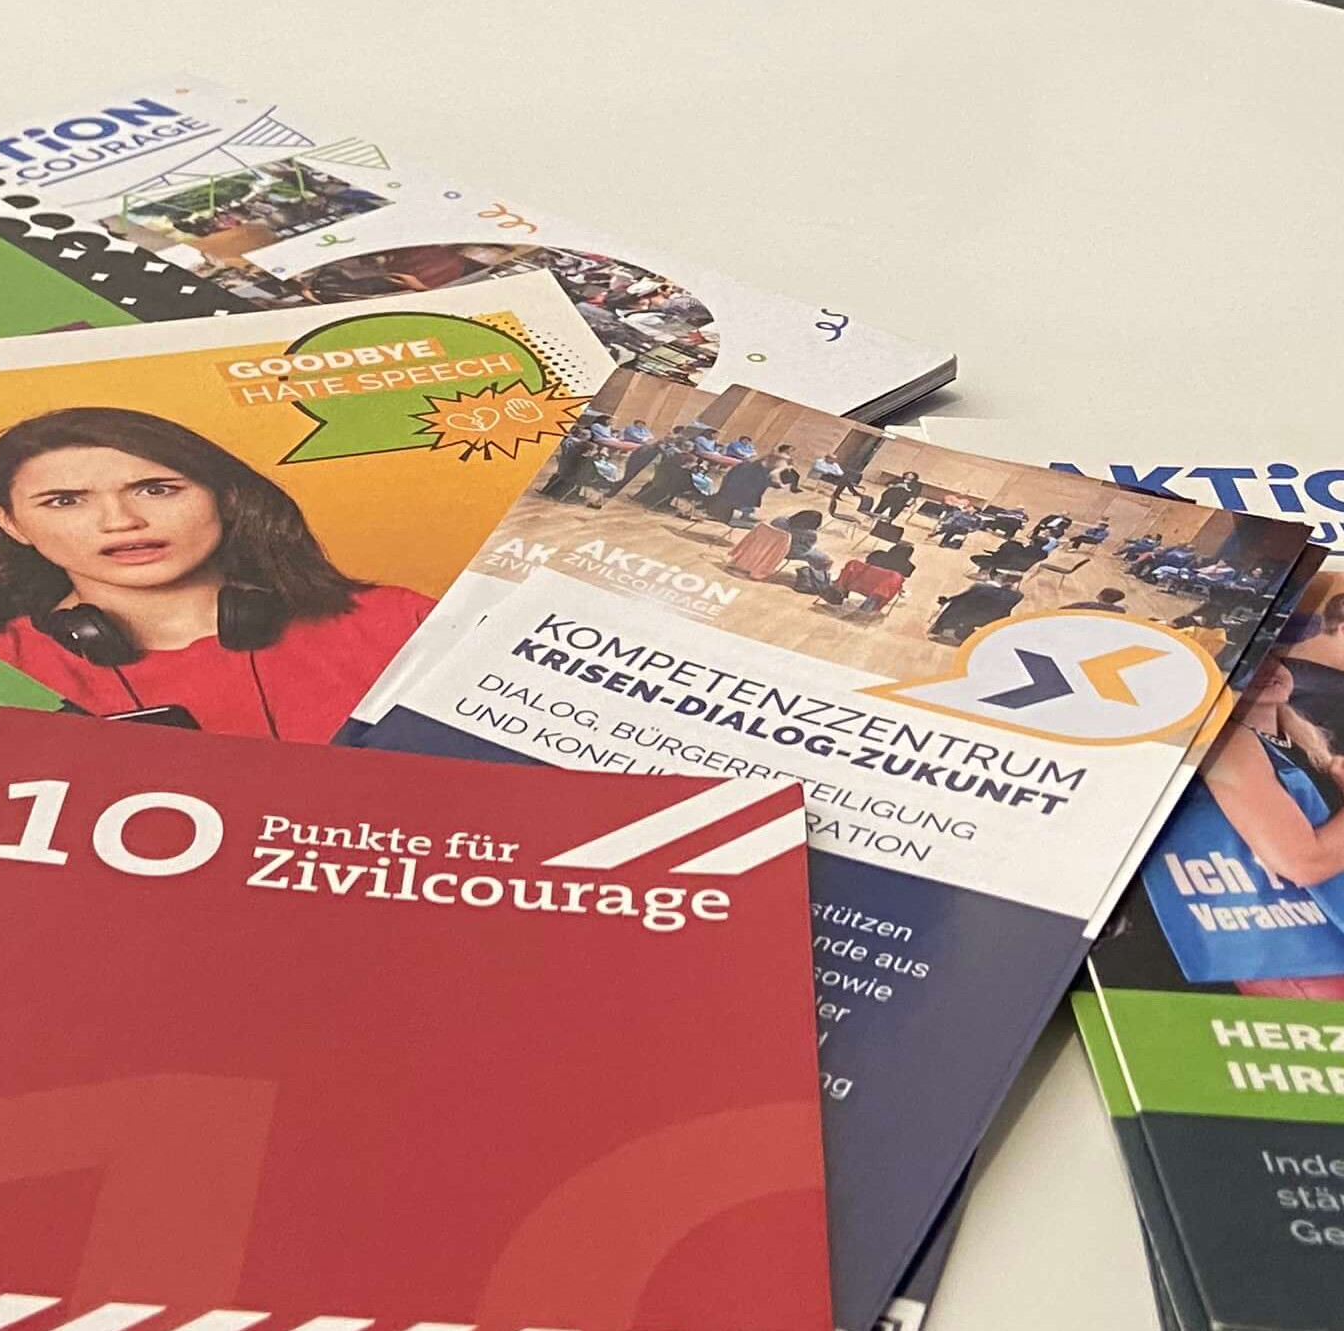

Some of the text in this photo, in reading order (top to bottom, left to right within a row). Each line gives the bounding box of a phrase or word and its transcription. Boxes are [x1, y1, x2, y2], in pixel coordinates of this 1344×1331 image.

[16, 116, 210, 184] COURAGE
[229, 339, 436, 379] GOODBYE
[242, 354, 511, 405] HATE SPEECH
[562, 553, 724, 618] ZIVILCOURAGE
[455, 697, 528, 736] UND
[476, 673, 599, 733] DIALOG,
[512, 636, 1070, 817] KRISEN-DIALOG-ZUKUNFT
[533, 613, 1087, 791] KOMPETENZZENTRUM
[257, 813, 435, 860] Punkte
[443, 830, 520, 864] für
[246, 845, 732, 932] Zivilcourage
[1164, 851, 1256, 896] Ich
[811, 903, 913, 942] stützen
[874, 952, 930, 979] aus
[816, 995, 851, 1022] er
